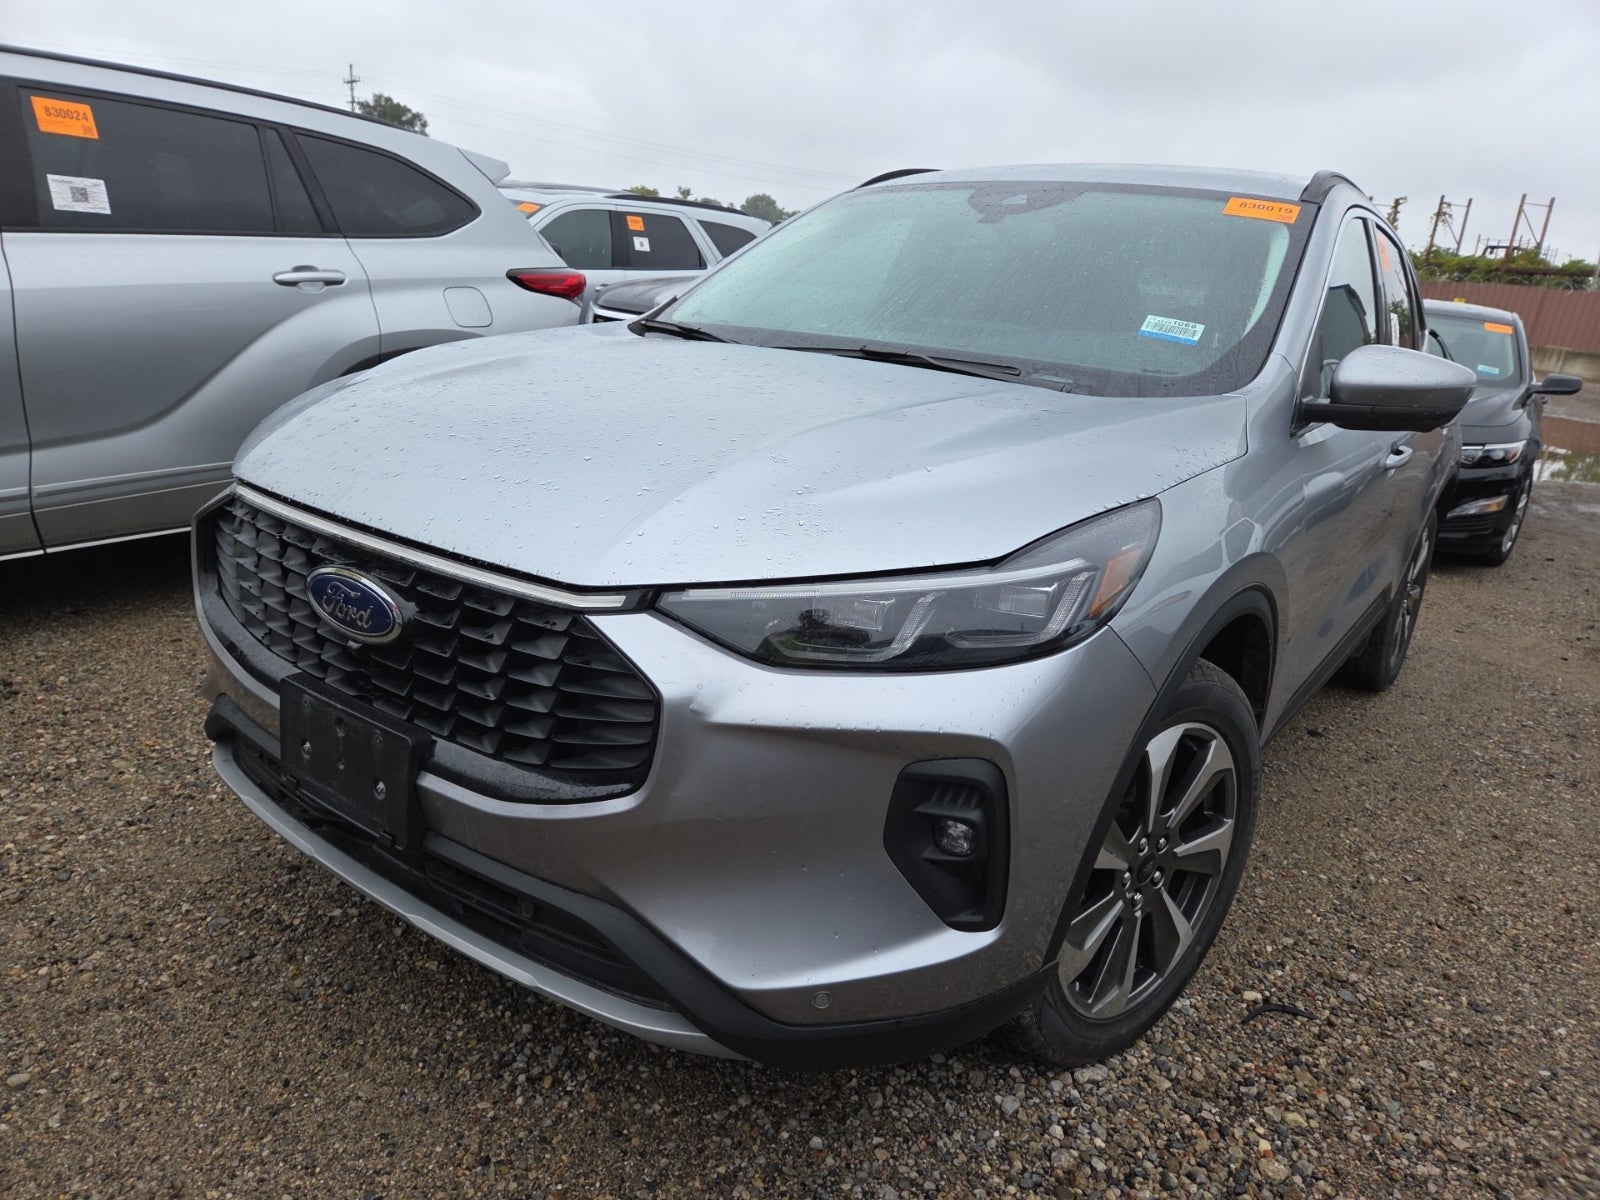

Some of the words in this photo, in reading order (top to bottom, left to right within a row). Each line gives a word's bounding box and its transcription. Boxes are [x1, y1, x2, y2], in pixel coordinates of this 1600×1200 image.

[43, 106, 89, 121] 830024
[1239, 202, 1293, 214] 830019
[321, 581, 375, 629] Ford
